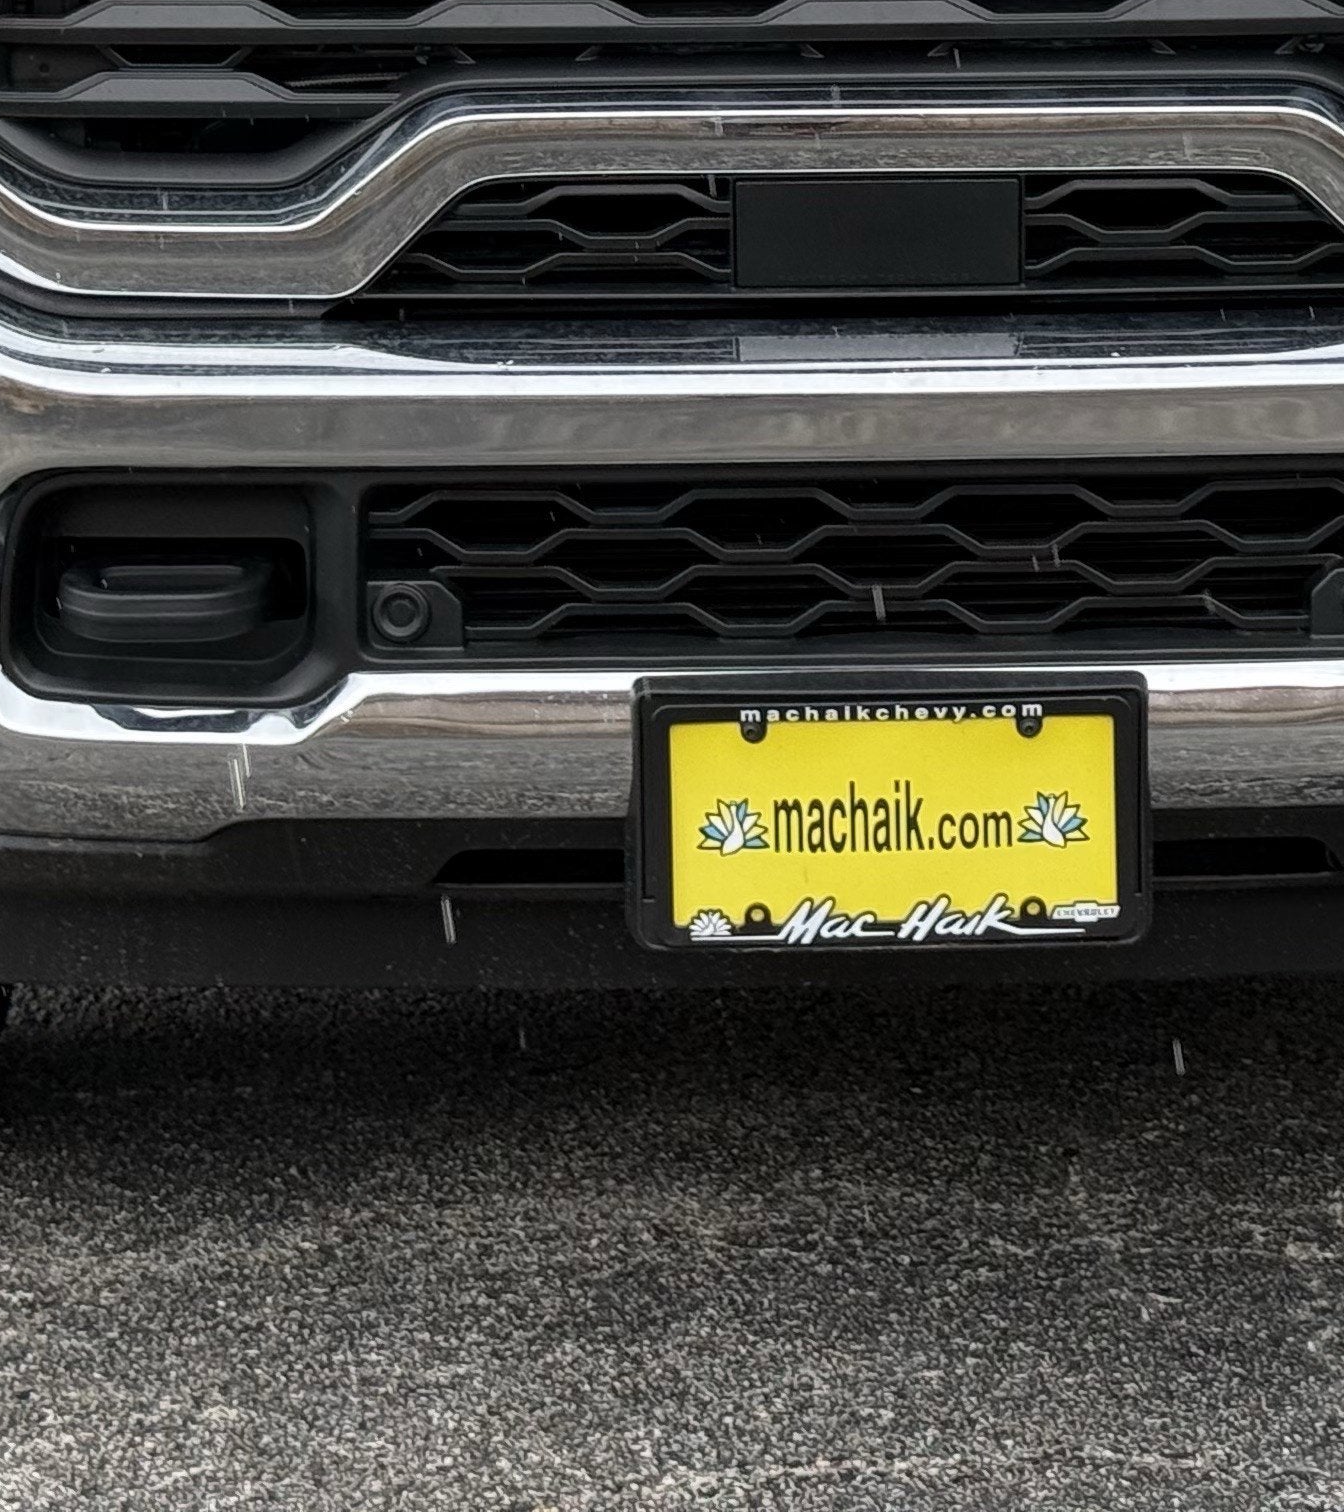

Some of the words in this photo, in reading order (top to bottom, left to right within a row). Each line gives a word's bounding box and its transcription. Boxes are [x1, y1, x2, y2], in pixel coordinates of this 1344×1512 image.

[739, 702, 1043, 723] machaikchevy.com
[773, 780, 1013, 854] machaik.com
[777, 896, 894, 945] Mac
